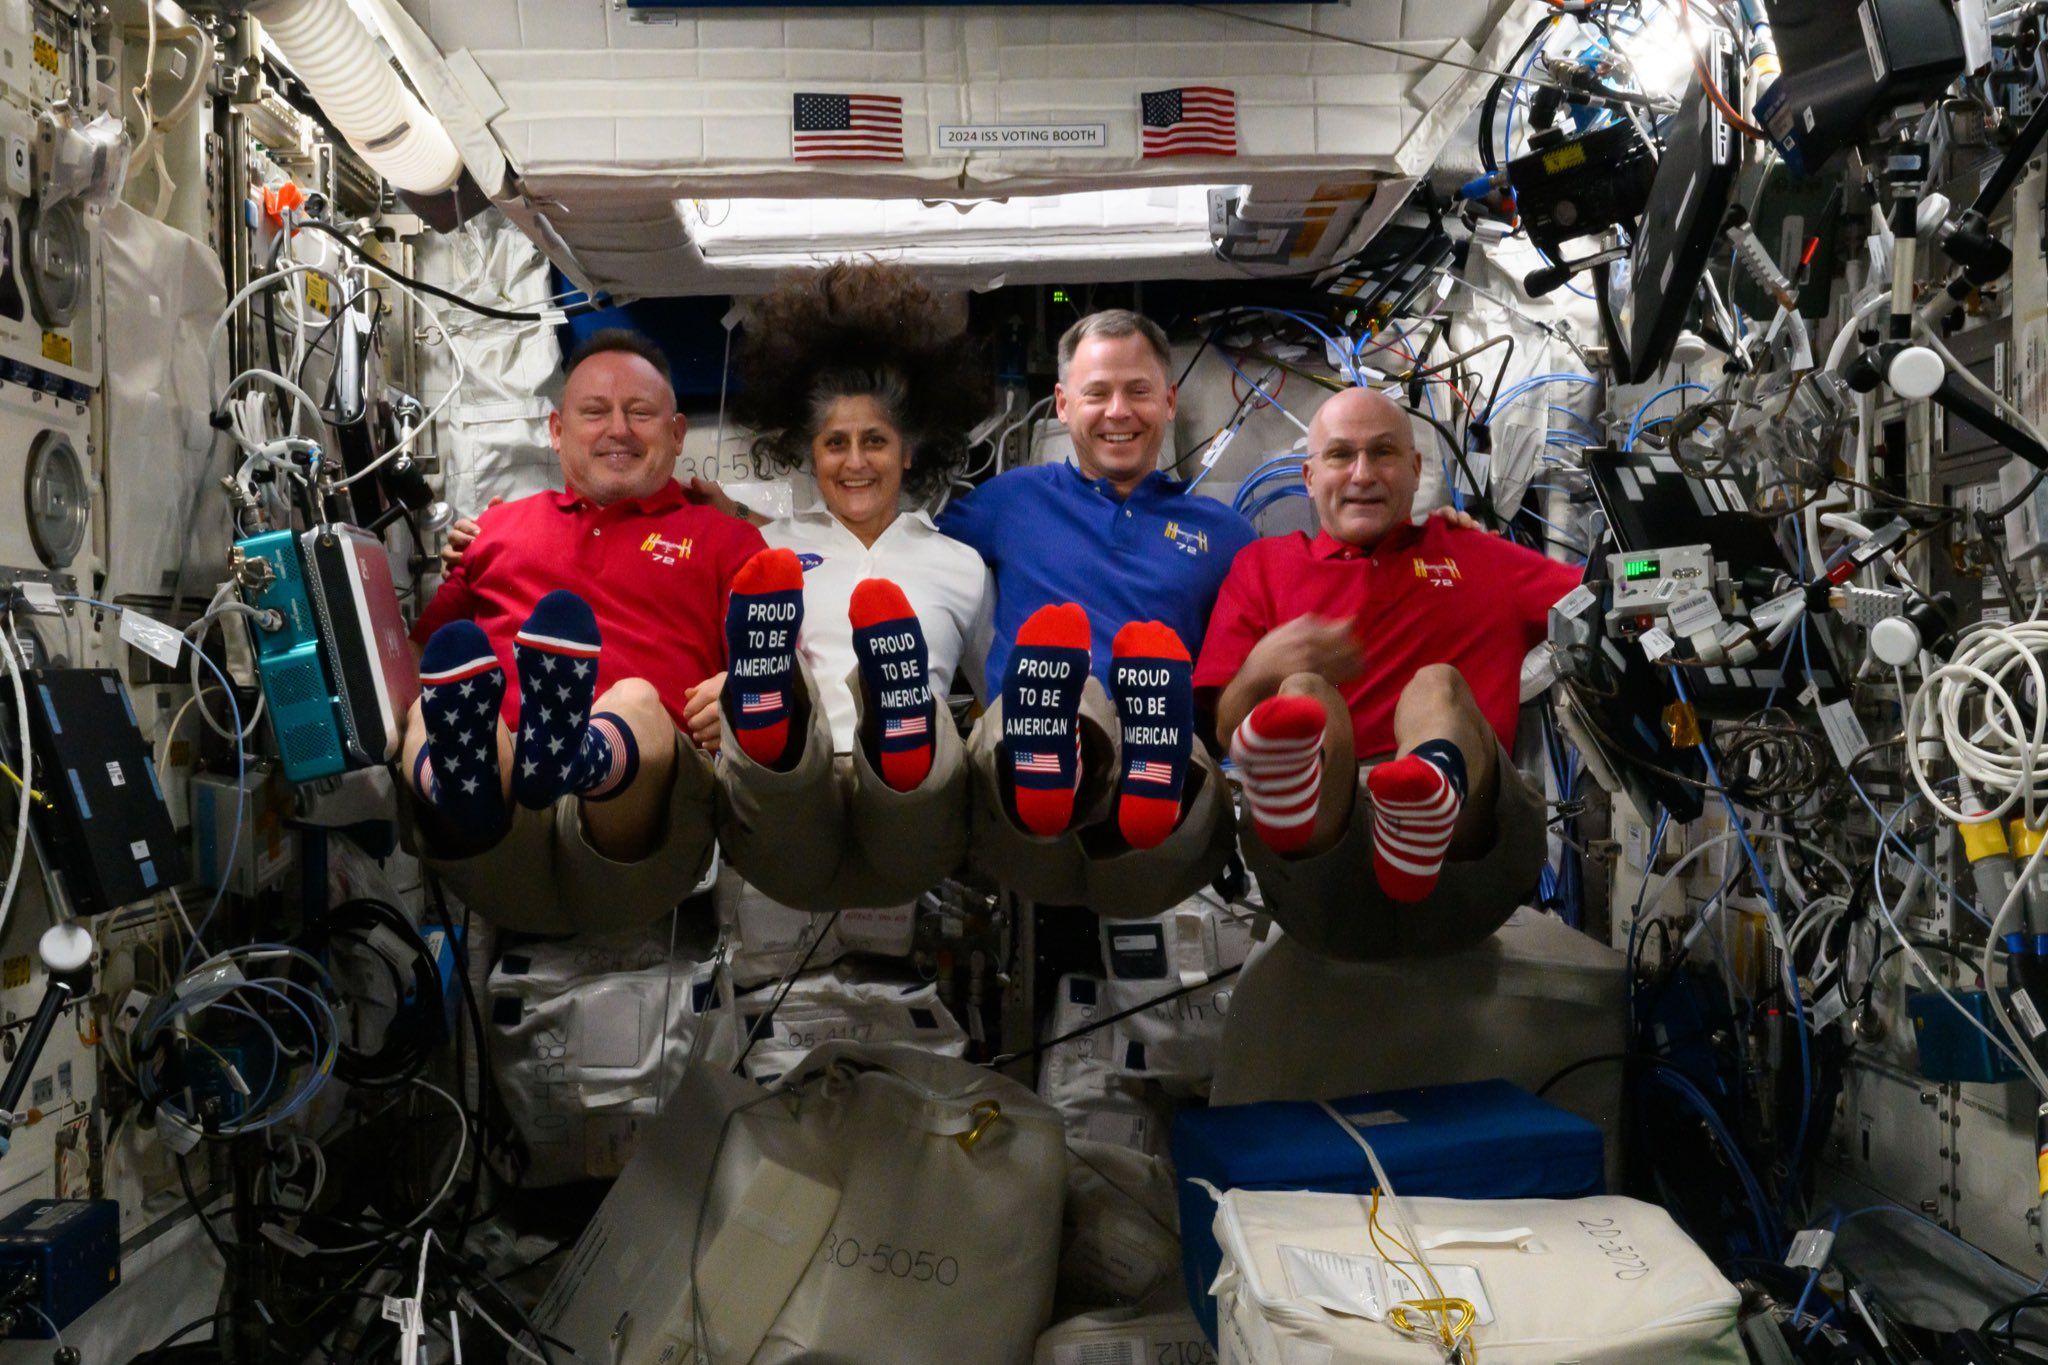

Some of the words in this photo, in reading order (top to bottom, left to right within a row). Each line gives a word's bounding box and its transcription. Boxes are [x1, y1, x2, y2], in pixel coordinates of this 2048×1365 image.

[948, 131, 978, 142] 2024
[981, 131, 998, 142] ISS
[1002, 130, 1049, 142] VOTING
[1053, 130, 1096, 141] BOOTH
[1176, 541, 1198, 556] 72
[651, 552, 675, 567] 72
[1429, 578, 1454, 588] 72
[747, 603, 796, 622] PROUD
[748, 631, 765, 649] TO
[768, 630, 788, 648] BE
[869, 632, 916, 656] PROUD
[734, 654, 792, 678] AMERICAN
[881, 664, 898, 681] TO
[902, 659, 920, 678] BE
[1017, 658, 1071, 679] PROUD
[1117, 667, 1170, 687] PROUD
[1019, 687, 1037, 706] TO
[1041, 689, 1062, 707] BE
[1125, 696, 1143, 716] TO
[1148, 696, 1166, 716] BE
[1006, 718, 1068, 736] AMERICAN
[1124, 726, 1179, 746] AMERICAN
